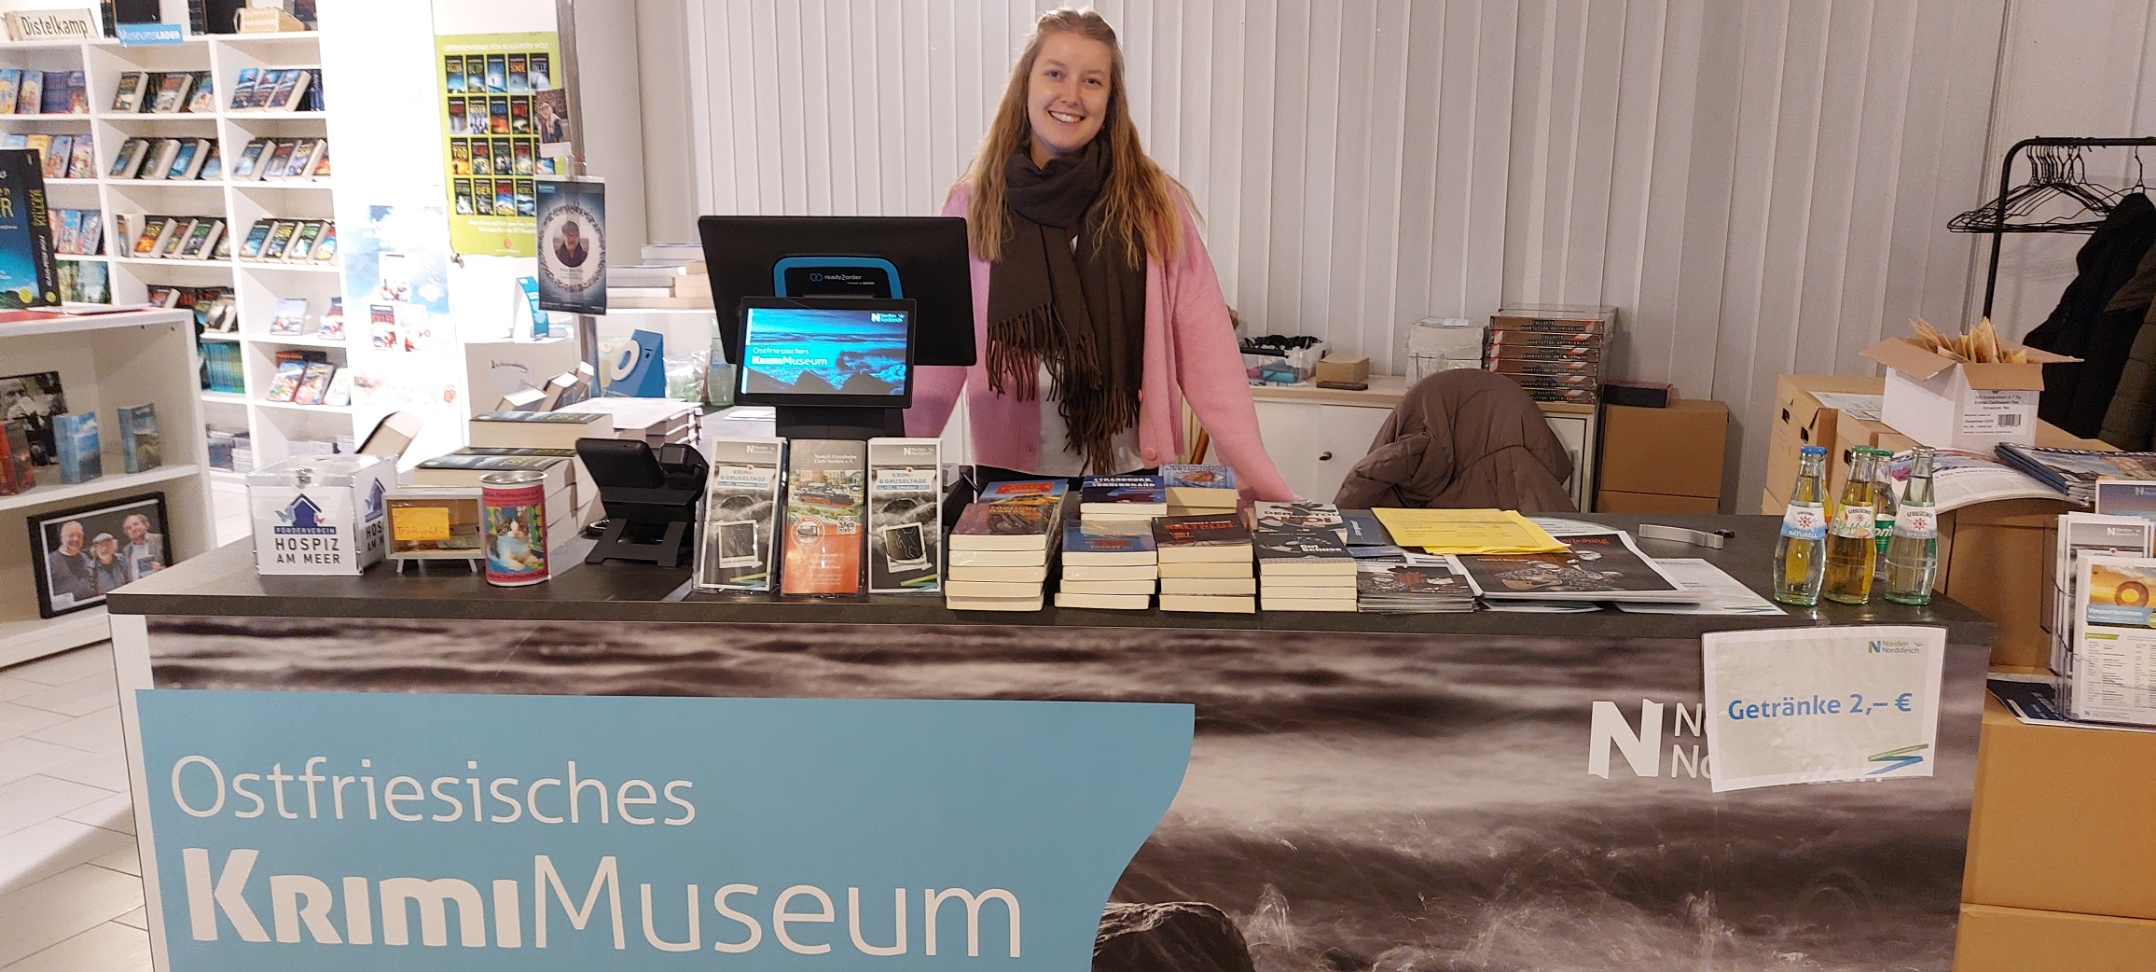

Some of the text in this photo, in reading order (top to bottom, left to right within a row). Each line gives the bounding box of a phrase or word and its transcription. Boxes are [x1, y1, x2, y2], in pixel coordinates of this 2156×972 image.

[20, 16, 88, 39] Distelkamp
[753, 347, 809, 355] Ostfriesisches
[366, 520, 383, 538] HOS
[275, 538, 339, 551] HOSPIZ
[277, 553, 341, 564] AM MEER
[1869, 641, 1881, 653] N
[1728, 695, 1841, 720] Getränke
[1588, 698, 1664, 779] N
[171, 755, 697, 827] Ostfriesisches
